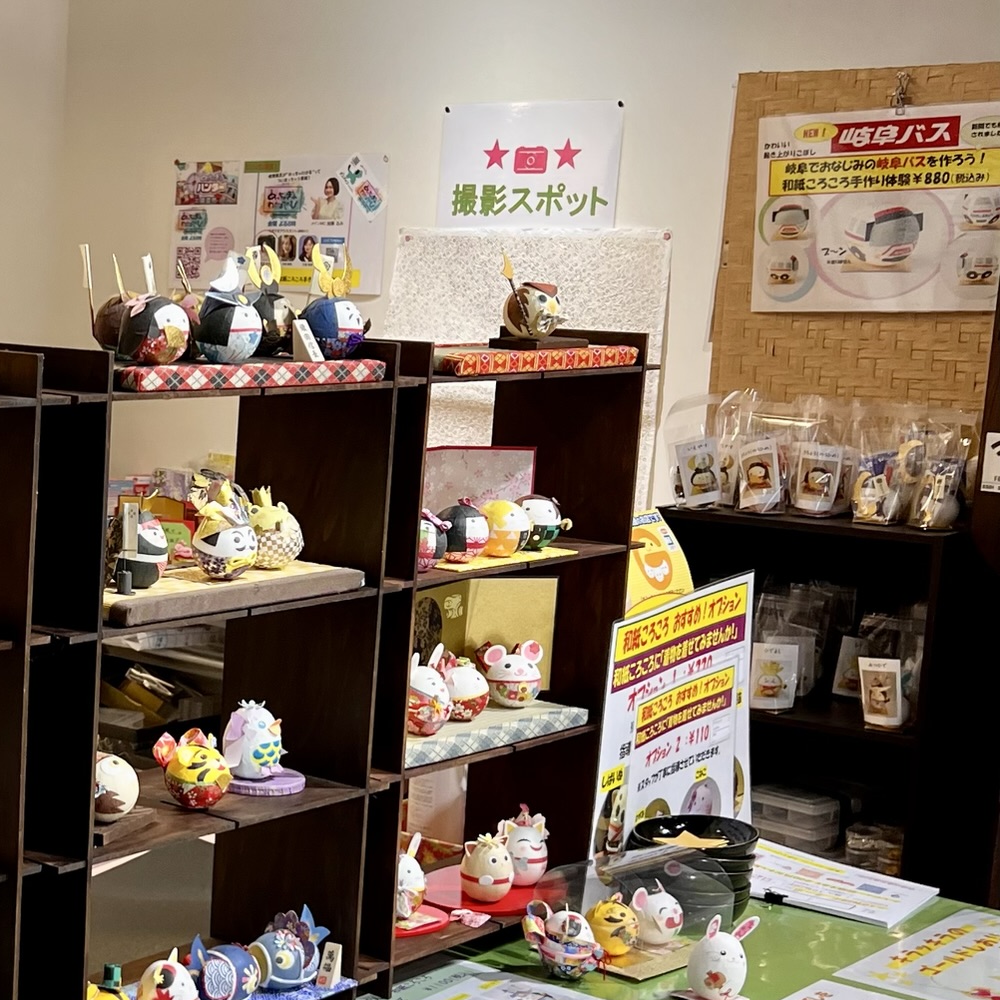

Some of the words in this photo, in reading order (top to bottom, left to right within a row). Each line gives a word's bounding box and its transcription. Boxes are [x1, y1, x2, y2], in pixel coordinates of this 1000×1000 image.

[838, 122, 952, 148] 岐阜バス
[451, 182, 609, 218] 撮影スポット
[623, 616, 670, 654] 和紙ころころ
